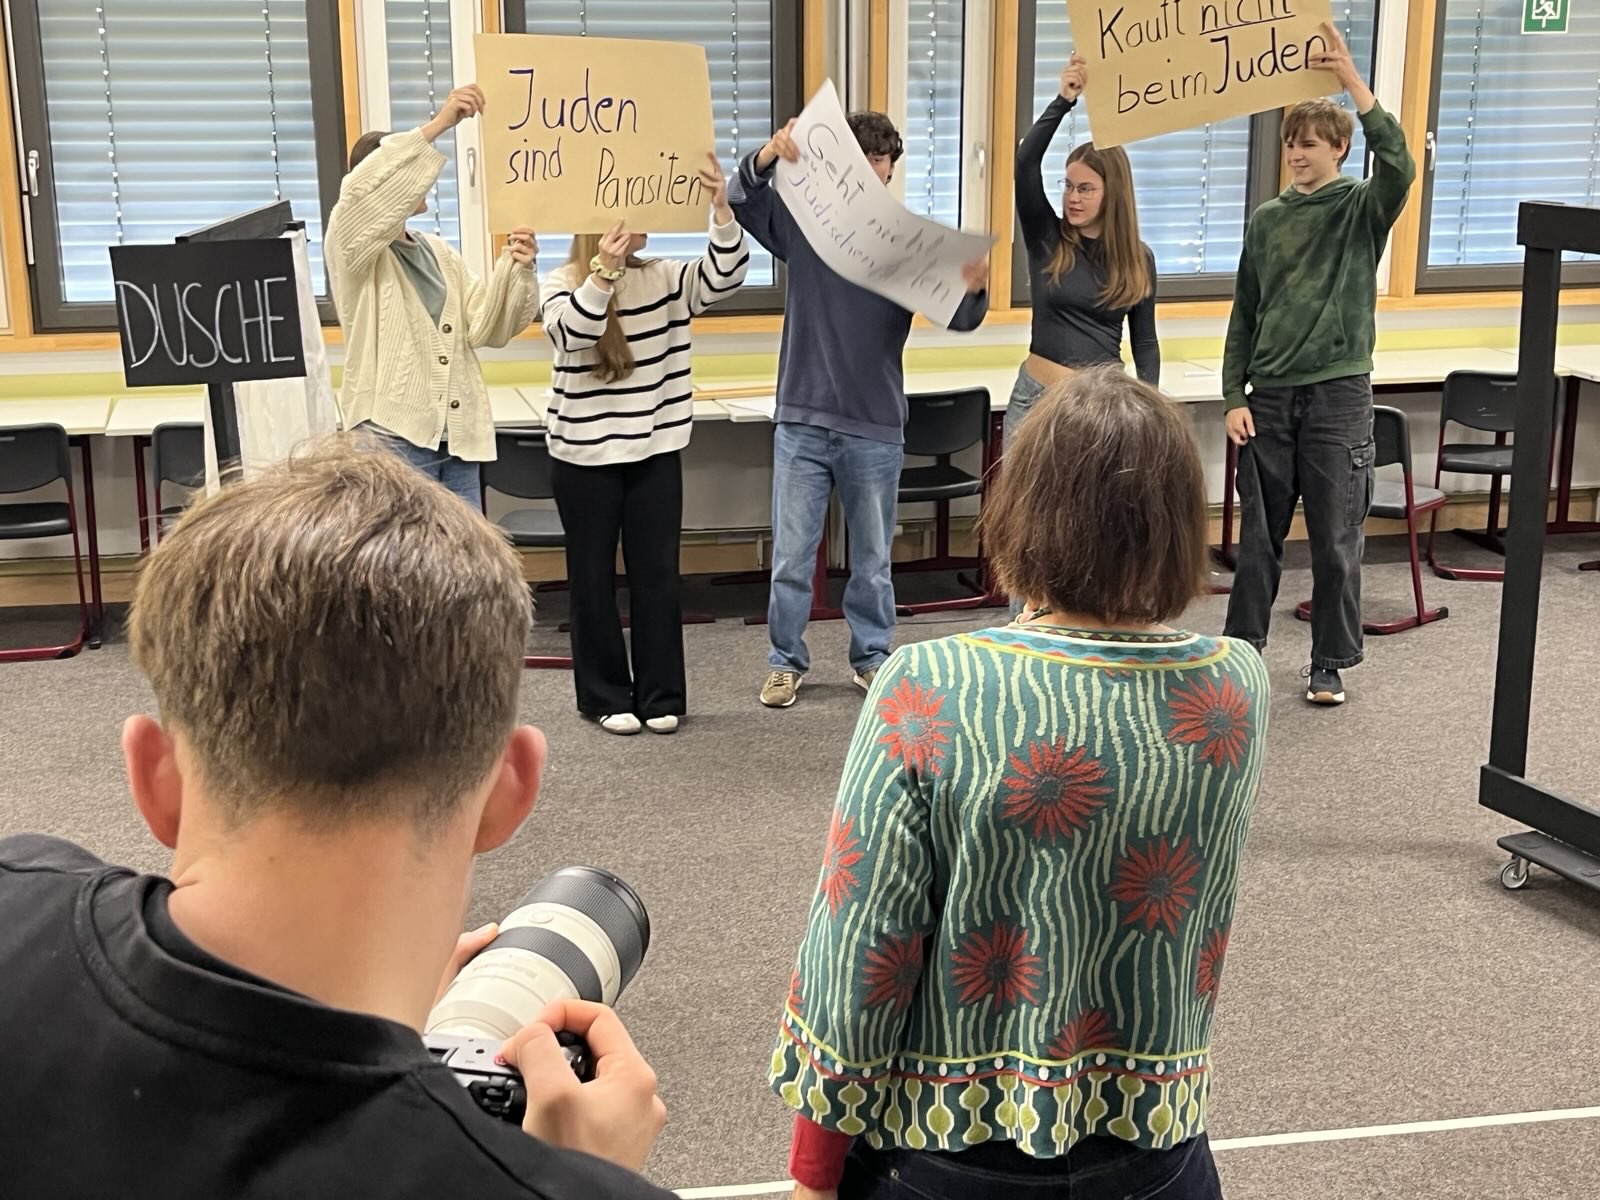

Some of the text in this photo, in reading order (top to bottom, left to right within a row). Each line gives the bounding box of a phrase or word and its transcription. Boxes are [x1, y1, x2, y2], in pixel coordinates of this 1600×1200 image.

[1098, 0, 1185, 60] Kauft
[508, 67, 637, 134] Juden
[1117, 27, 1327, 114] beim Juden
[505, 136, 702, 209] sind Parasiten
[807, 122, 865, 206] Geht
[115, 276, 296, 369] DUSCHE
